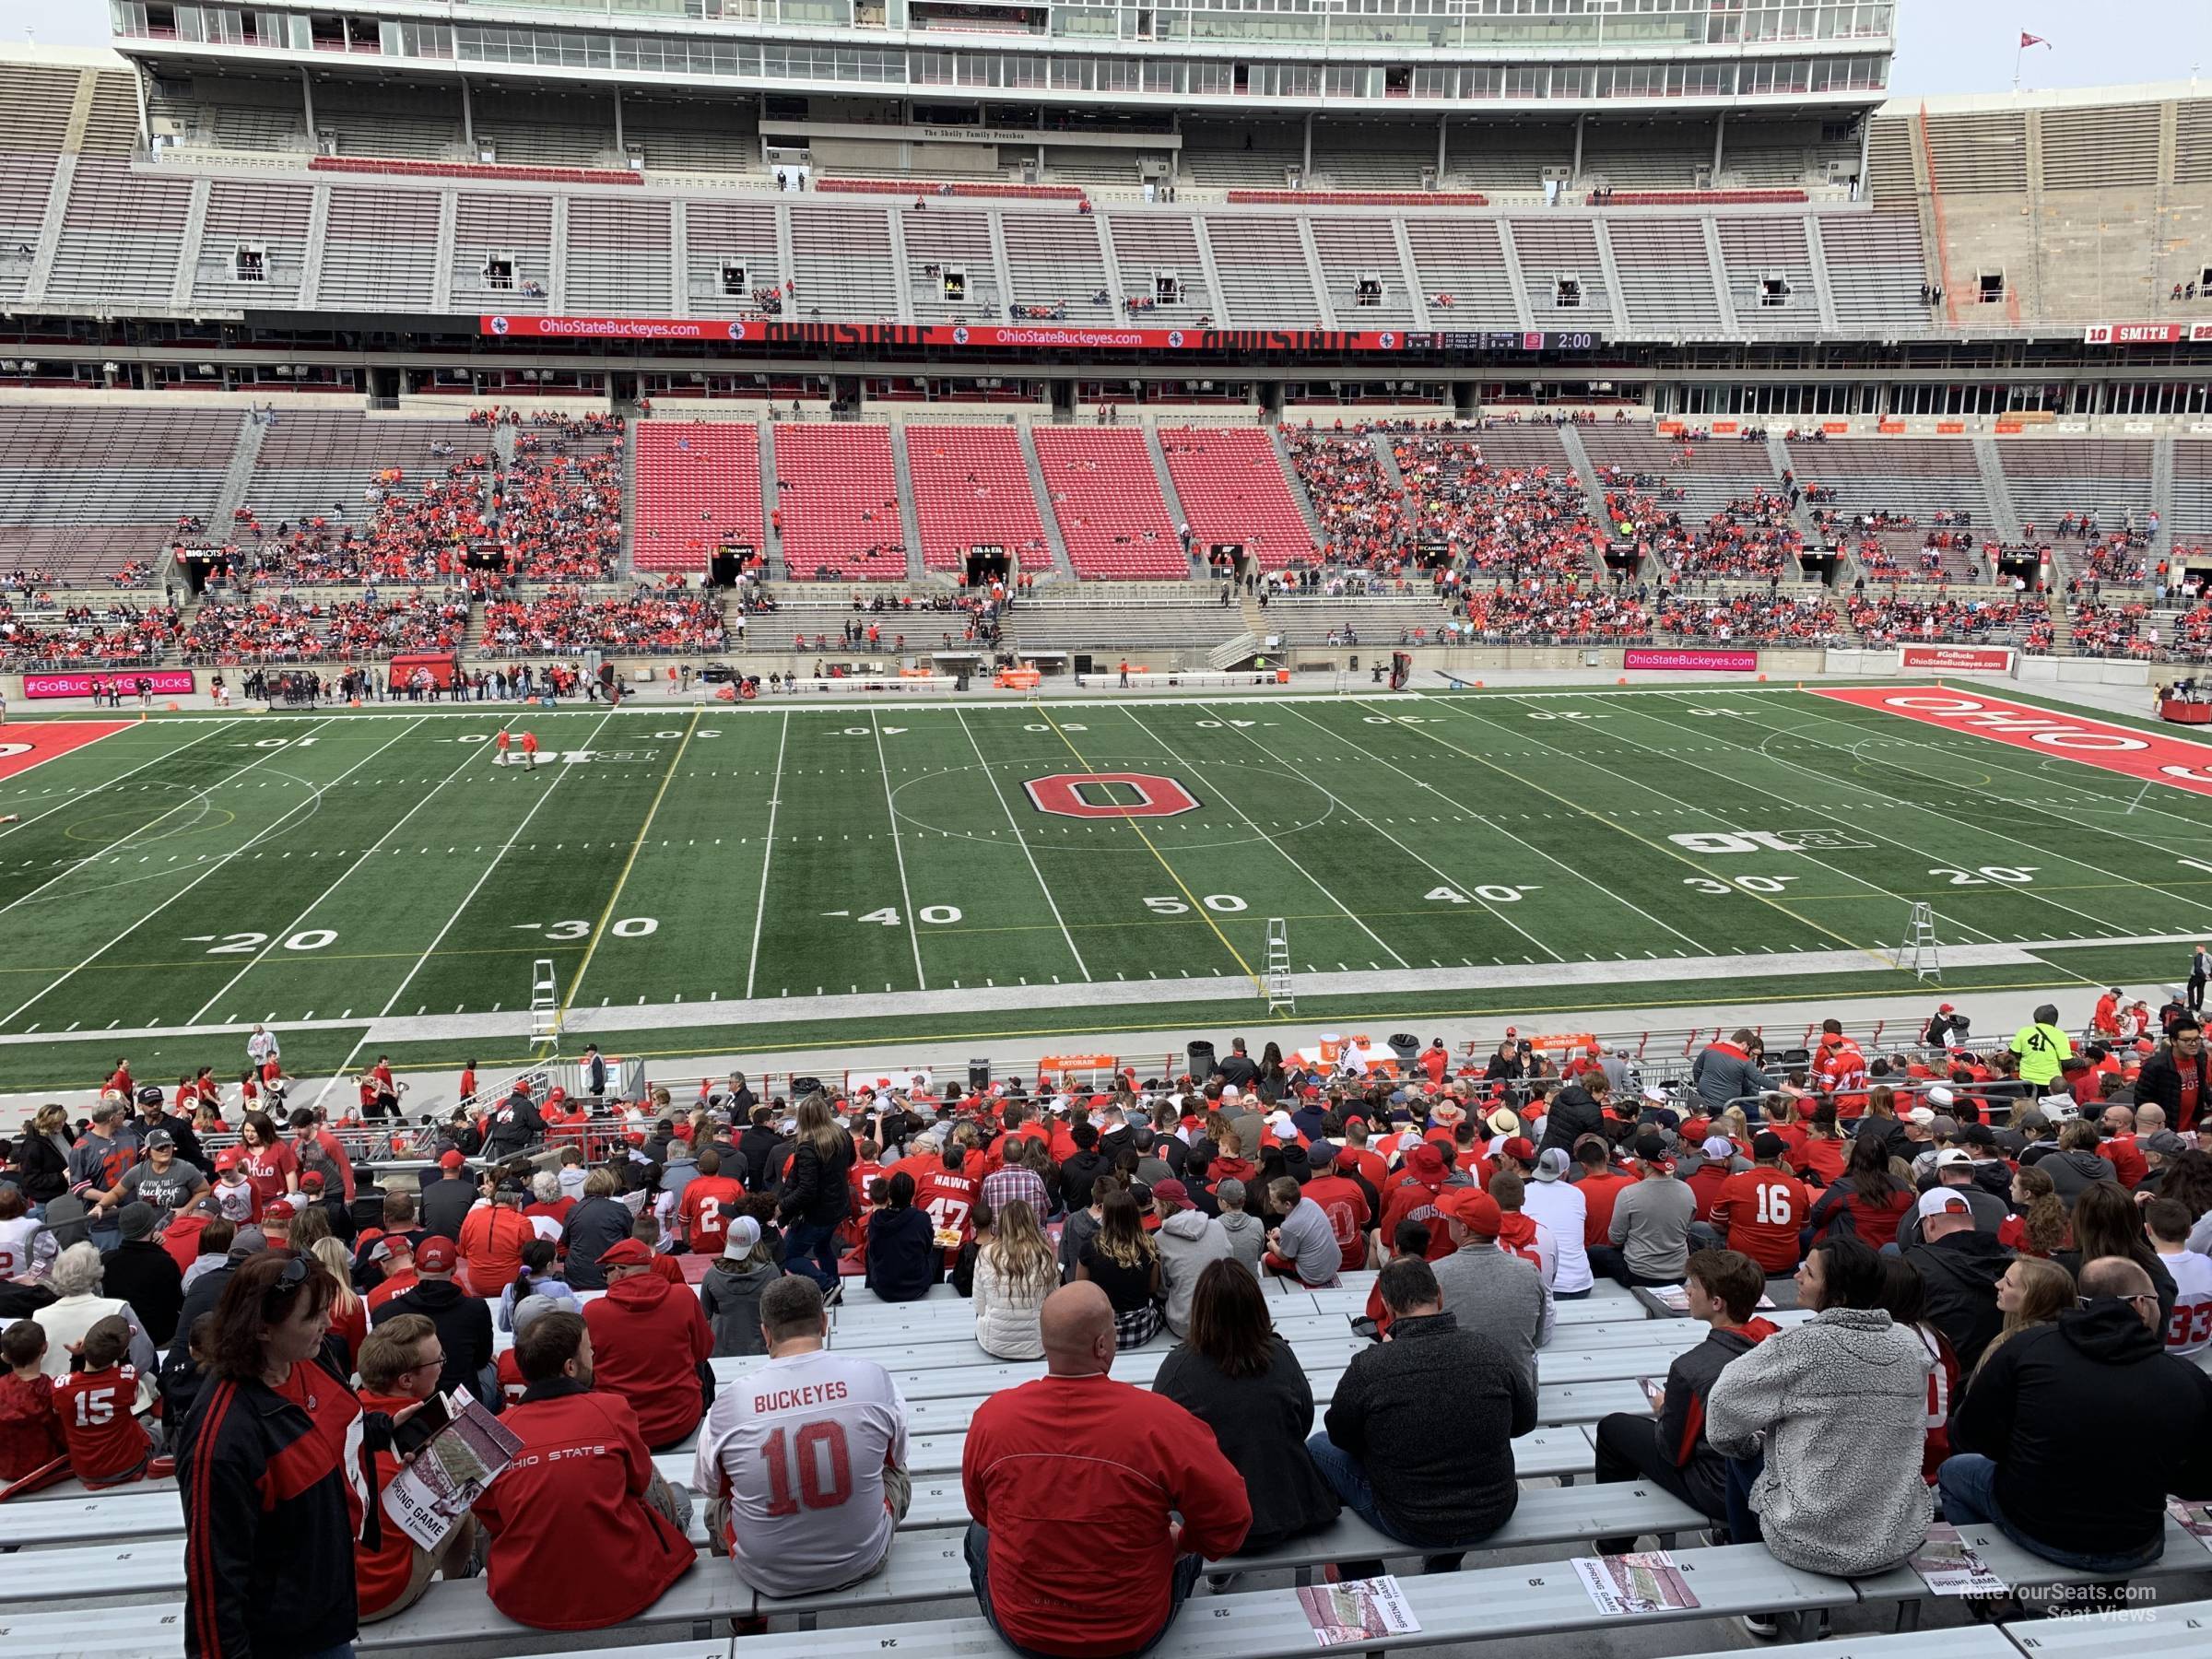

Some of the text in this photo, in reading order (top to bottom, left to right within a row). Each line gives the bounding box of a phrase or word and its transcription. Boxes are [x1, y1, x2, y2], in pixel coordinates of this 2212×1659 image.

[940, 130, 962, 138] Shelly
[966, 131, 990, 139] Family
[994, 131, 1025, 139] Pressbox
[539, 320, 700, 337] OhioStateBuckeyes.com
[2089, 326, 2170, 341] 10 SMITH
[996, 329, 1142, 346] OhioStateBuckeyes.com
[1558, 334, 1591, 347] 2:00
[971, 546, 984, 554] Elk
[991, 546, 1003, 554] Elk
[1628, 653, 1755, 668] OhioStateBuckeyes.com
[1909, 658, 2001, 669] OhioStateBuckeyes.com
[1936, 652, 1974, 660] #GoBucks
[1882, 696, 2152, 751] OHIO
[1927, 866, 2033, 885] 20
[1423, 884, 1524, 903] 40
[1683, 876, 1785, 894] 30
[1142, 894, 1248, 913] 50
[857, 905, 962, 925] 40
[545, 917, 659, 940] 30
[206, 929, 339, 954] 20
[1543, 1039, 1579, 1048] GATORADE
[934, 1174, 971, 1191] HAWK
[1756, 1182, 1791, 1225] 16
[700, 1196, 721, 1233] 2
[924, 1197, 970, 1230] 47
[754, 1381, 848, 1414] BUCKEYES
[75, 1388, 115, 1427] 15
[548, 1445, 606, 1462] STATE
[759, 1418, 853, 1517] 10
[391, 1477, 414, 1510] SPRING
[413, 1506, 444, 1537] GAME
[1976, 1537, 1990, 1546] 17
[1681, 1563, 1695, 1572] 19
[1528, 1577, 1545, 1587] 20
[1583, 1561, 1605, 1591] SPRING
[1600, 1592, 1618, 1613] GAME
[1932, 1576, 1998, 1588] SPRING GAME
[1376, 1578, 1408, 1629] SPRING GAME
[1214, 1609, 1230, 1618] 22
[880, 1639, 897, 1648] 24
[2023, 1637, 2041, 1648] 18
